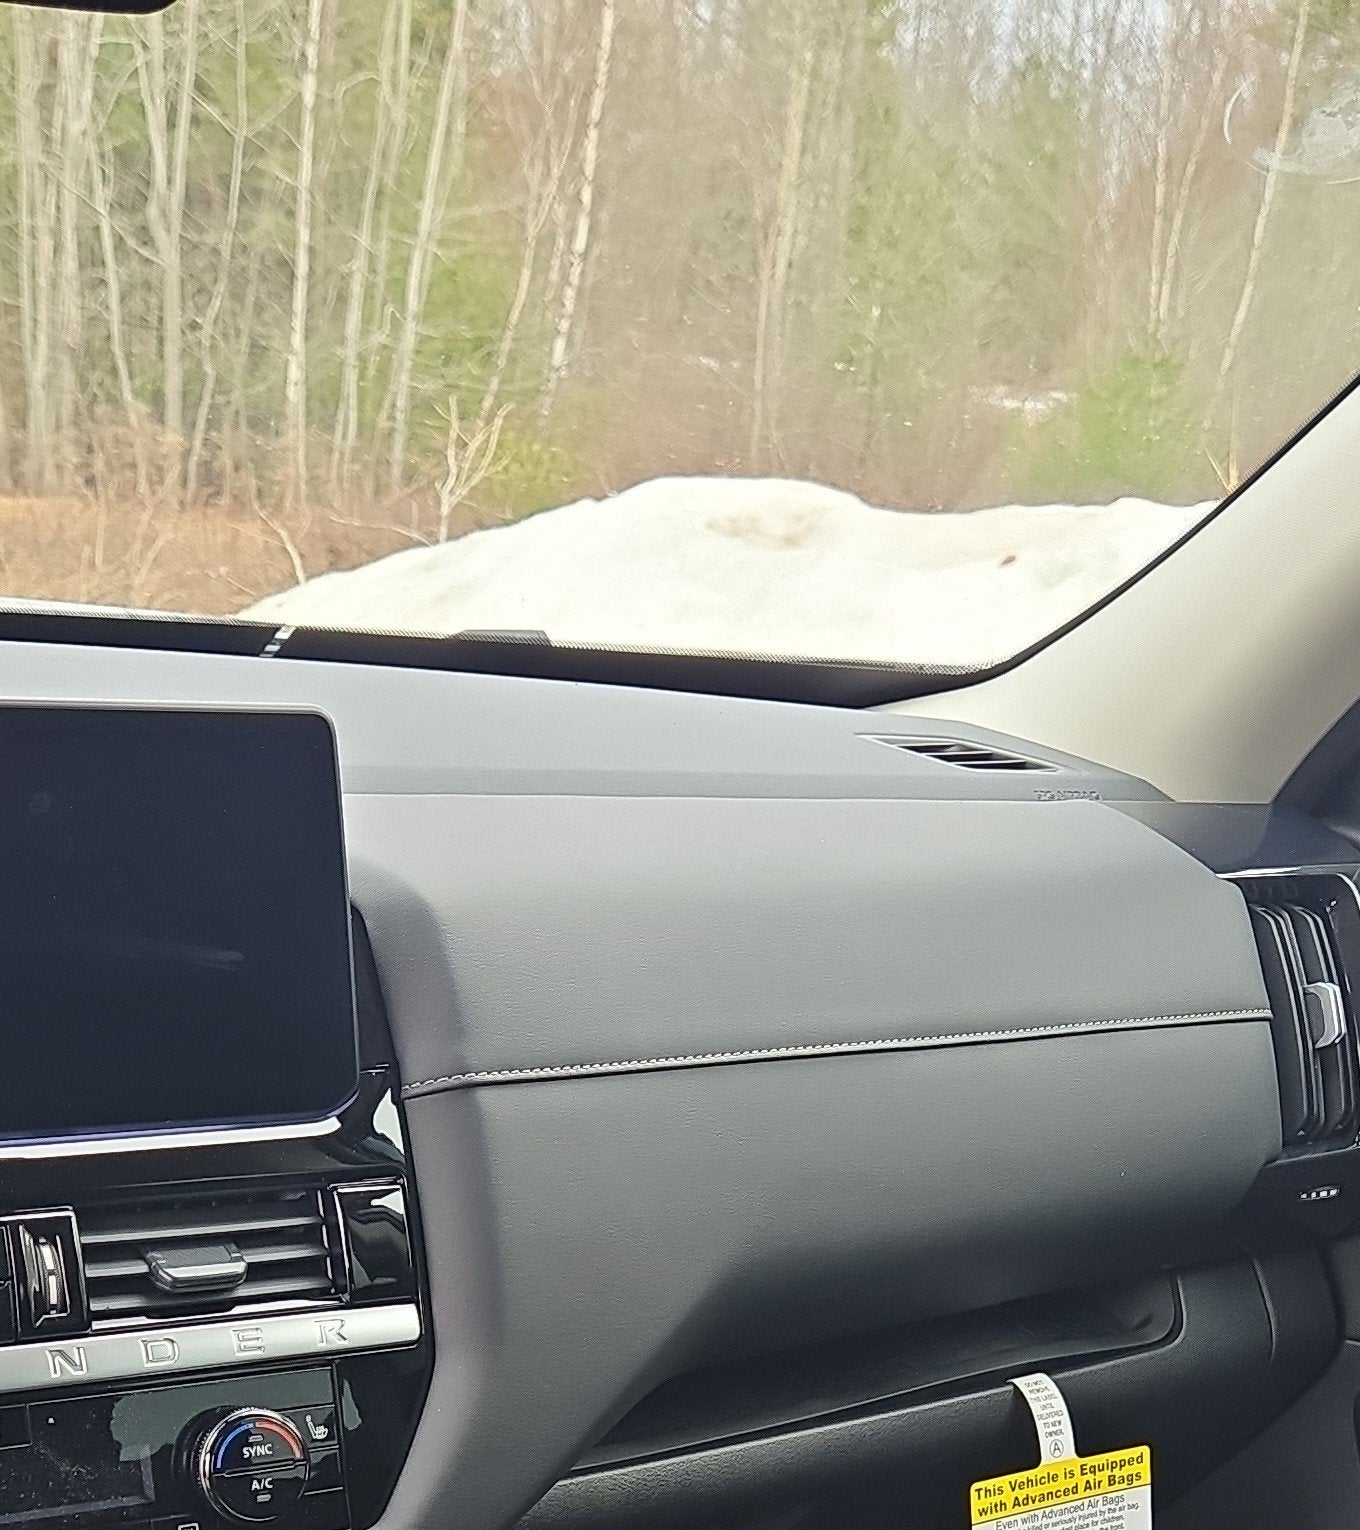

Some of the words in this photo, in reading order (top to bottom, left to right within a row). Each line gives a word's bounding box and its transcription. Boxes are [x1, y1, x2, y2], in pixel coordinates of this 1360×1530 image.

[242, 1443, 273, 1459] SYNC
[1053, 1441, 1062, 1455] A
[251, 1477, 274, 1491] A/C
[975, 1484, 1004, 1501] This
[1009, 1471, 1059, 1492] Vehicle
[1064, 1468, 1075, 1480] is
[1080, 1452, 1144, 1476] Equipped
[978, 1500, 1007, 1517] with
[1012, 1482, 1079, 1509] Advanced
[1083, 1478, 1103, 1492] Air
[1108, 1471, 1142, 1487] Bags
[1021, 1513, 1039, 1525] with
[1041, 1501, 1085, 1521] Advanced
[1087, 1498, 1100, 1510] Air
[1102, 1494, 1125, 1507] Bags
[1051, 1516, 1077, 1527] seriously
[1078, 1510, 1098, 1521] injured
[1099, 1509, 1106, 1517] by
[1107, 1506, 1117, 1514] the
